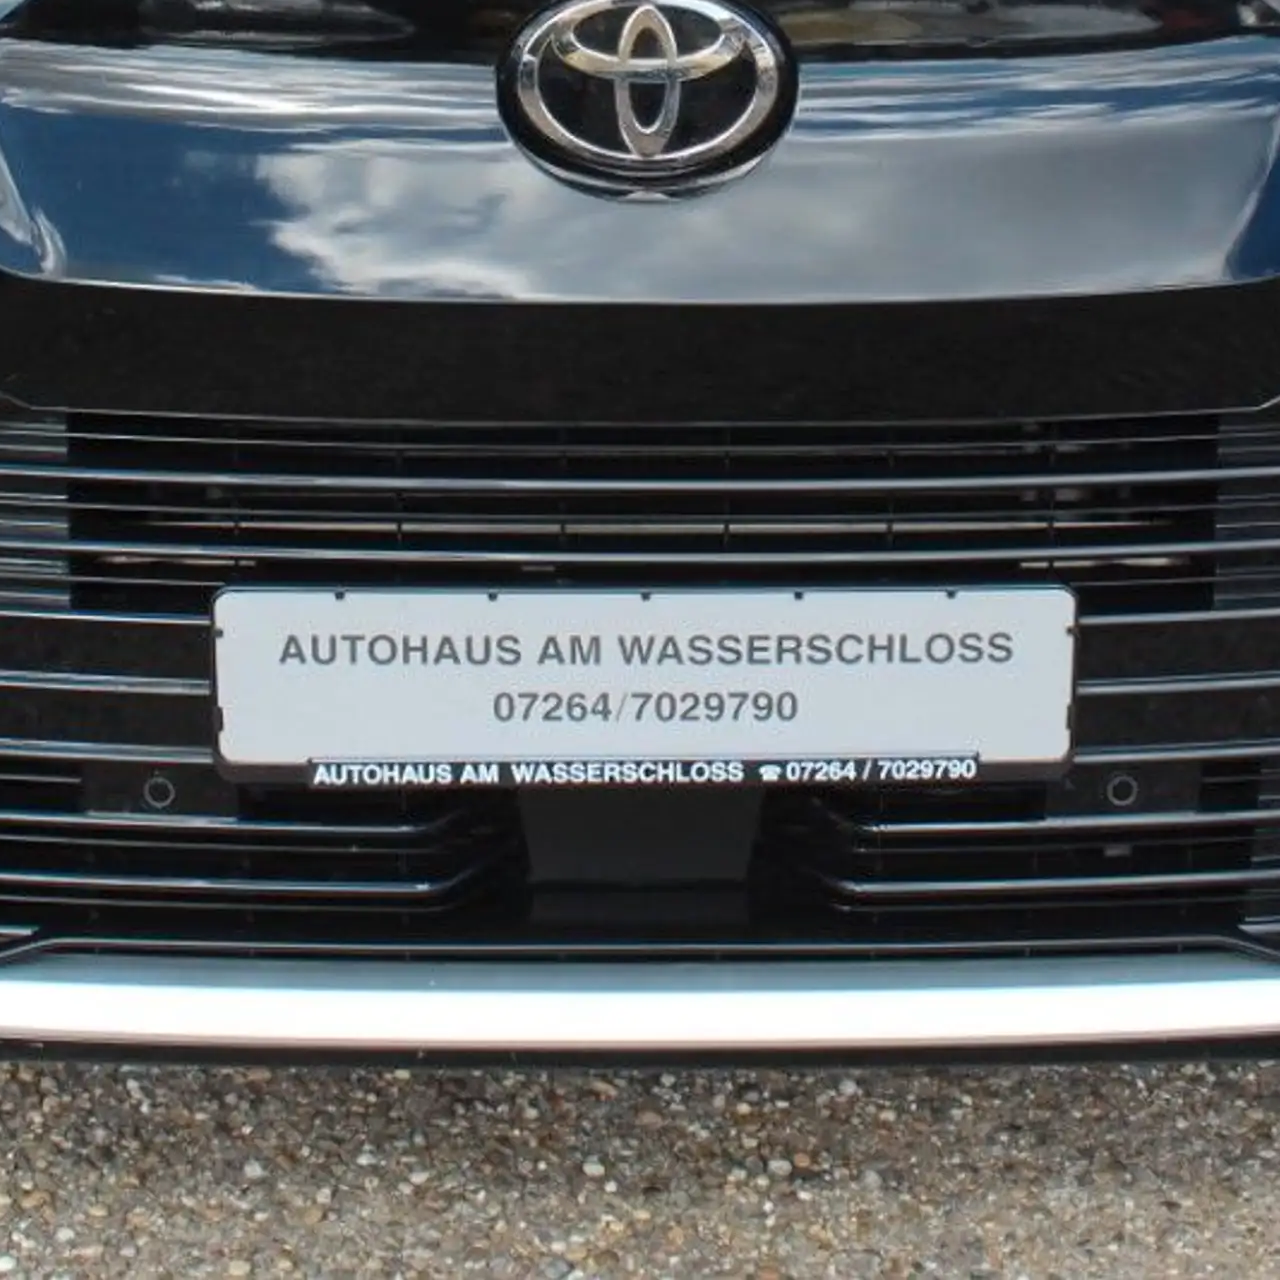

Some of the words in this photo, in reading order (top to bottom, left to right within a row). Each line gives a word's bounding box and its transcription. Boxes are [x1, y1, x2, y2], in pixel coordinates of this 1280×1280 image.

[279, 634, 522, 666] AUTOHAUS
[537, 634, 602, 666] AM
[619, 632, 1014, 666] WASSERSCHLOSS
[492, 690, 799, 723] 07264/7029790
[313, 763, 452, 786] AUTOHAUS
[460, 762, 500, 785] AM
[511, 760, 745, 784] WASSERSCHLOSS
[878, 756, 977, 780] 7029790
